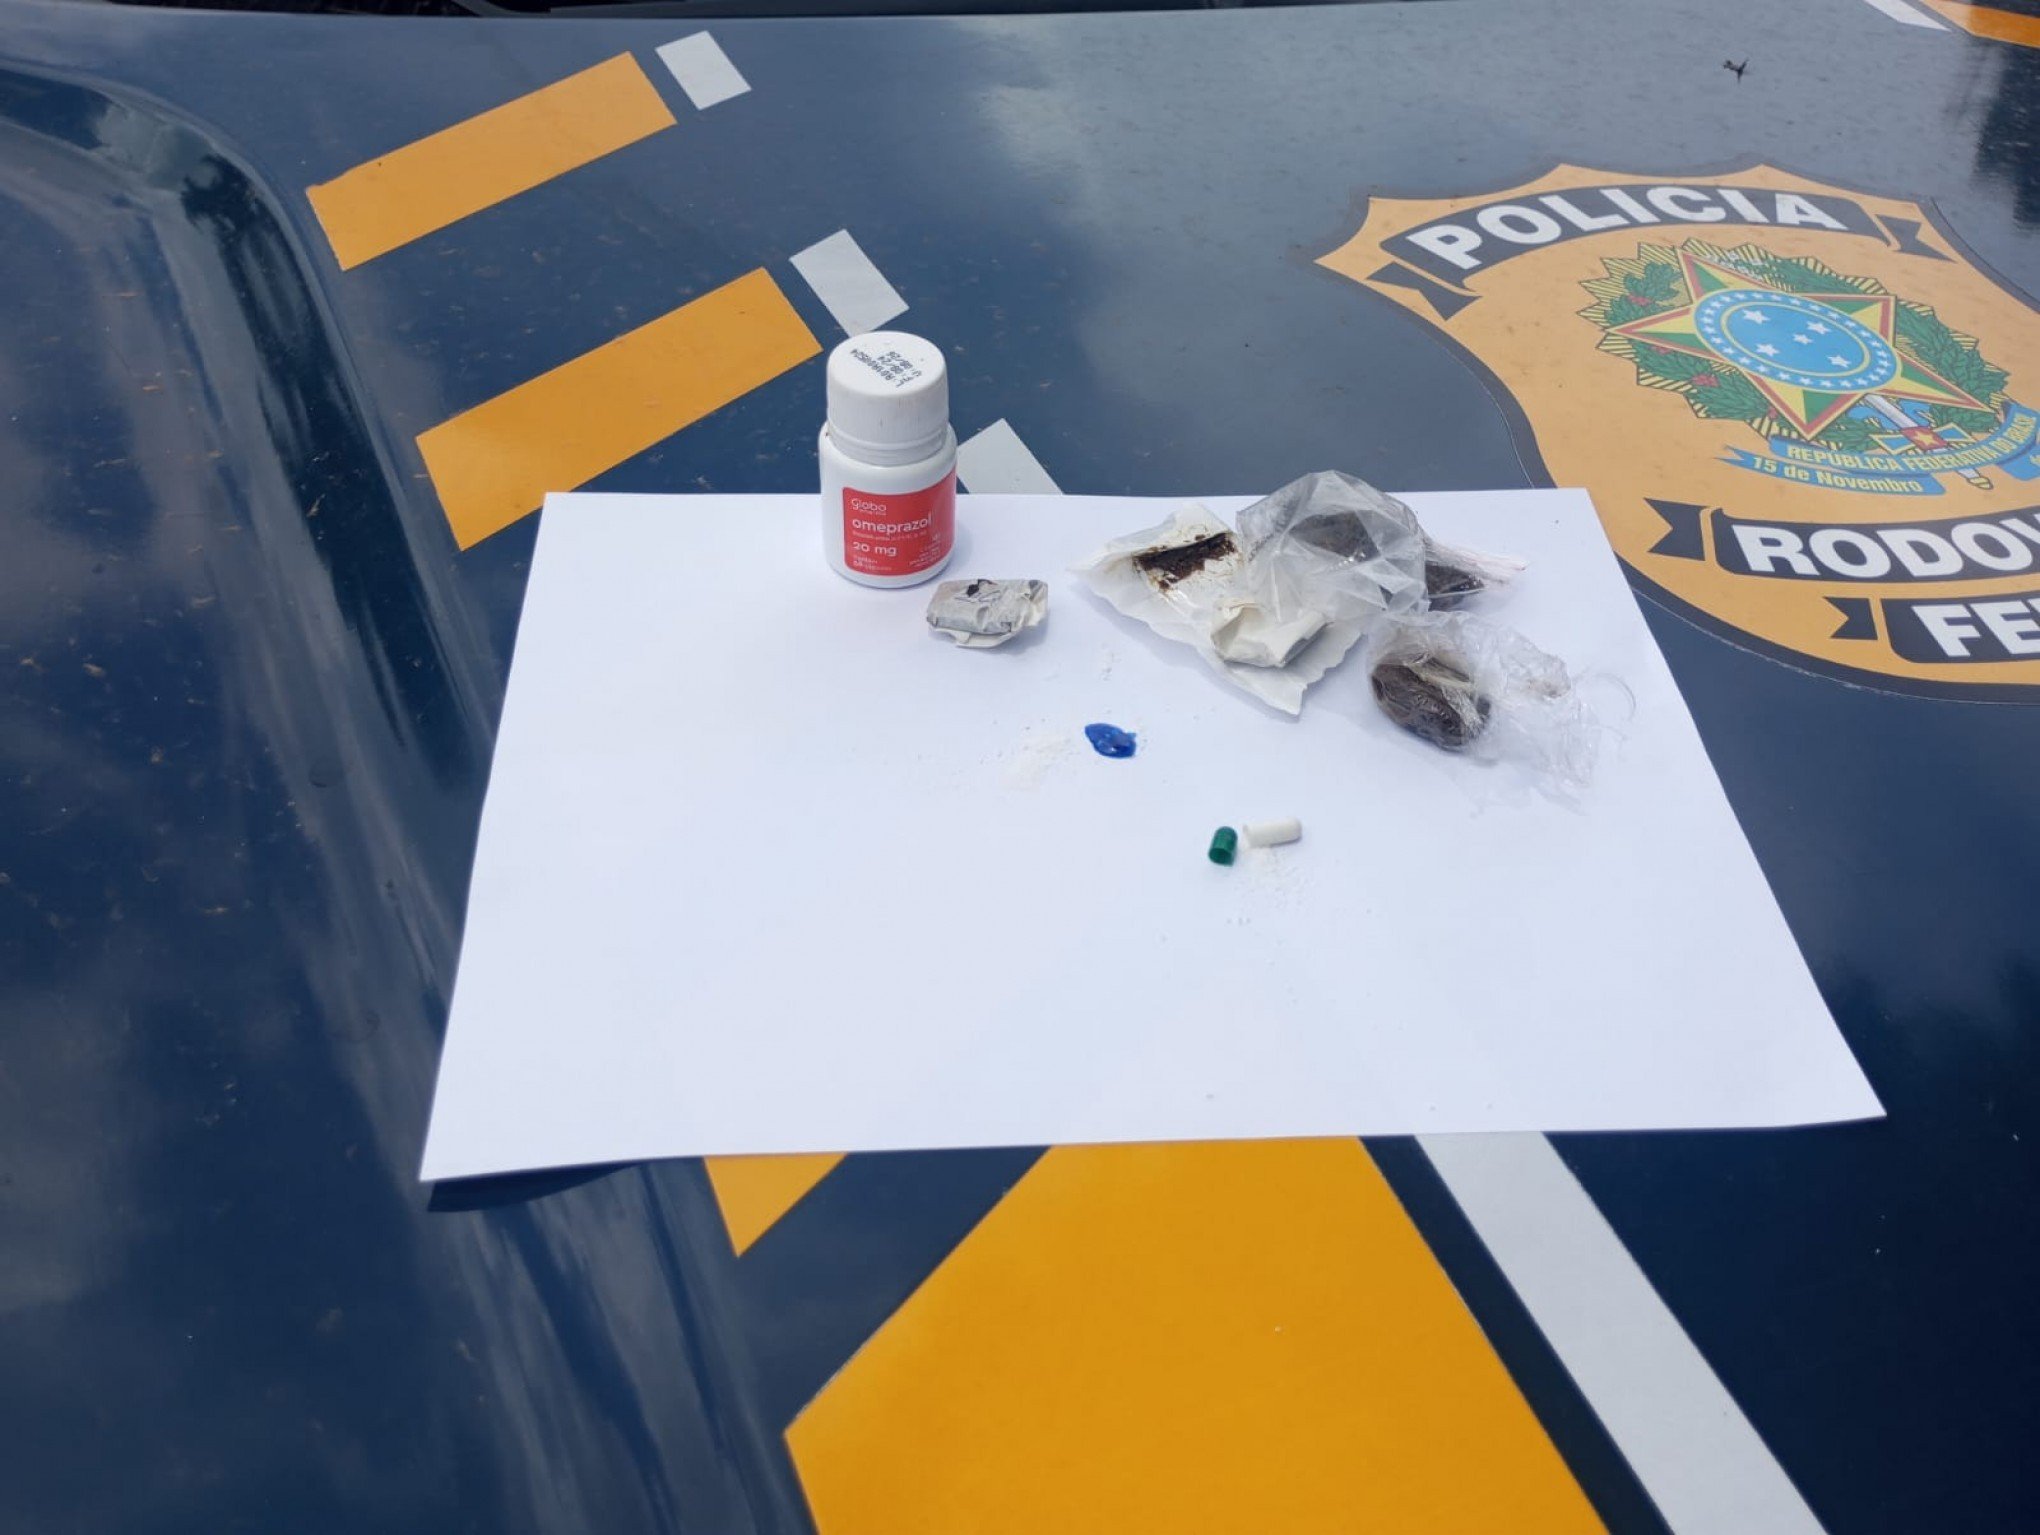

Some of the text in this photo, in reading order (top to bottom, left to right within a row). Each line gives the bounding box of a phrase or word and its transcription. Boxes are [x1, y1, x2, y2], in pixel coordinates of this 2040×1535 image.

[1406, 186, 1849, 270] POLICIA
[1753, 457, 1923, 493] 15 de Novembro
[852, 511, 932, 534] omeprazol
[852, 541, 869, 552] 20
[875, 546, 897, 557] mg
[1911, 598, 2040, 657] FE
